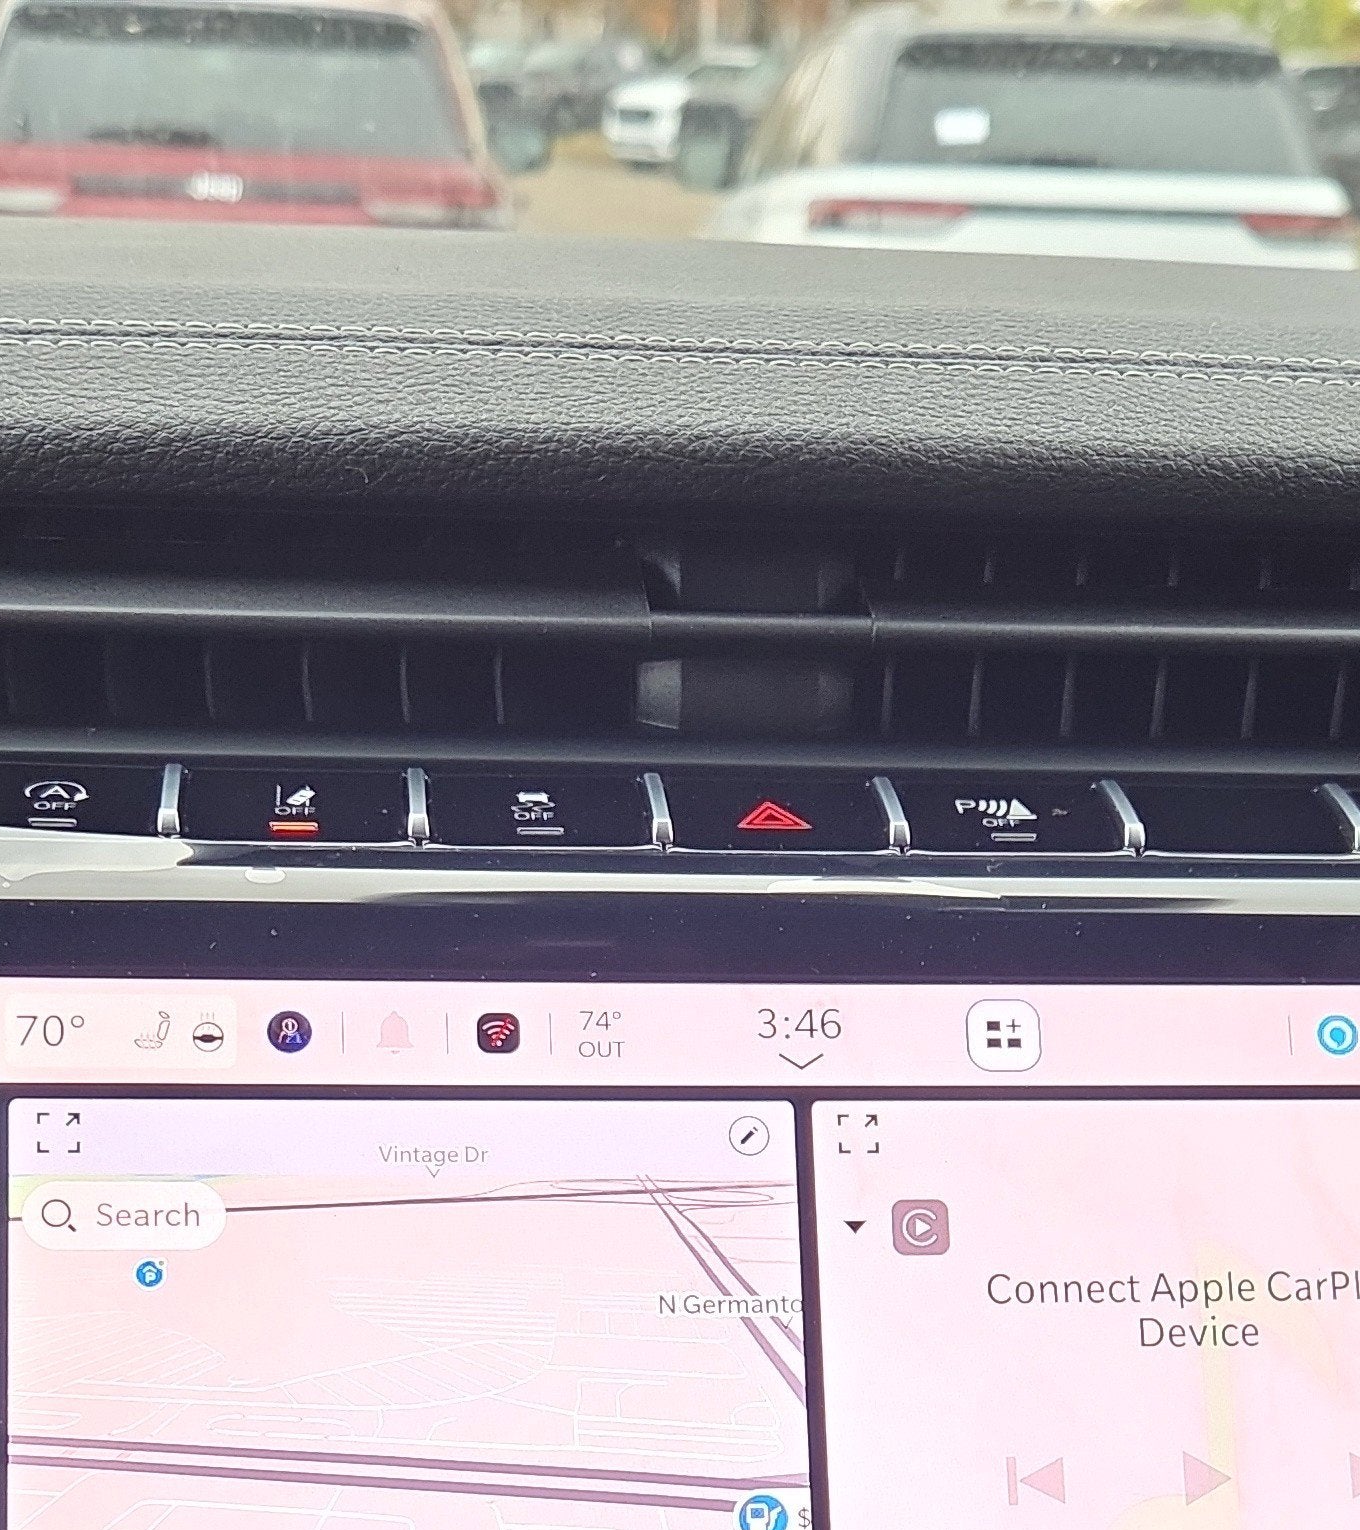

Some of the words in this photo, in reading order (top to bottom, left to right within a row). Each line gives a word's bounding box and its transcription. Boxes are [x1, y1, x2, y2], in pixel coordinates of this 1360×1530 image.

[33, 800, 77, 811] OFF
[274, 806, 316, 816] OFF
[513, 811, 555, 821] OFF
[981, 817, 1021, 828] OFF
[15, 1014, 85, 1048] 70°
[578, 1009, 622, 1032] 74°
[756, 1007, 843, 1041] 3:46
[577, 1040, 626, 1059] OUT
[377, 1144, 460, 1167] Vintage
[463, 1144, 489, 1164] Dr
[95, 1201, 202, 1229] Search
[986, 1272, 1142, 1306] Connect
[1150, 1271, 1256, 1310] Apple
[658, 1294, 676, 1315] N
[1138, 1315, 1261, 1349] Device
